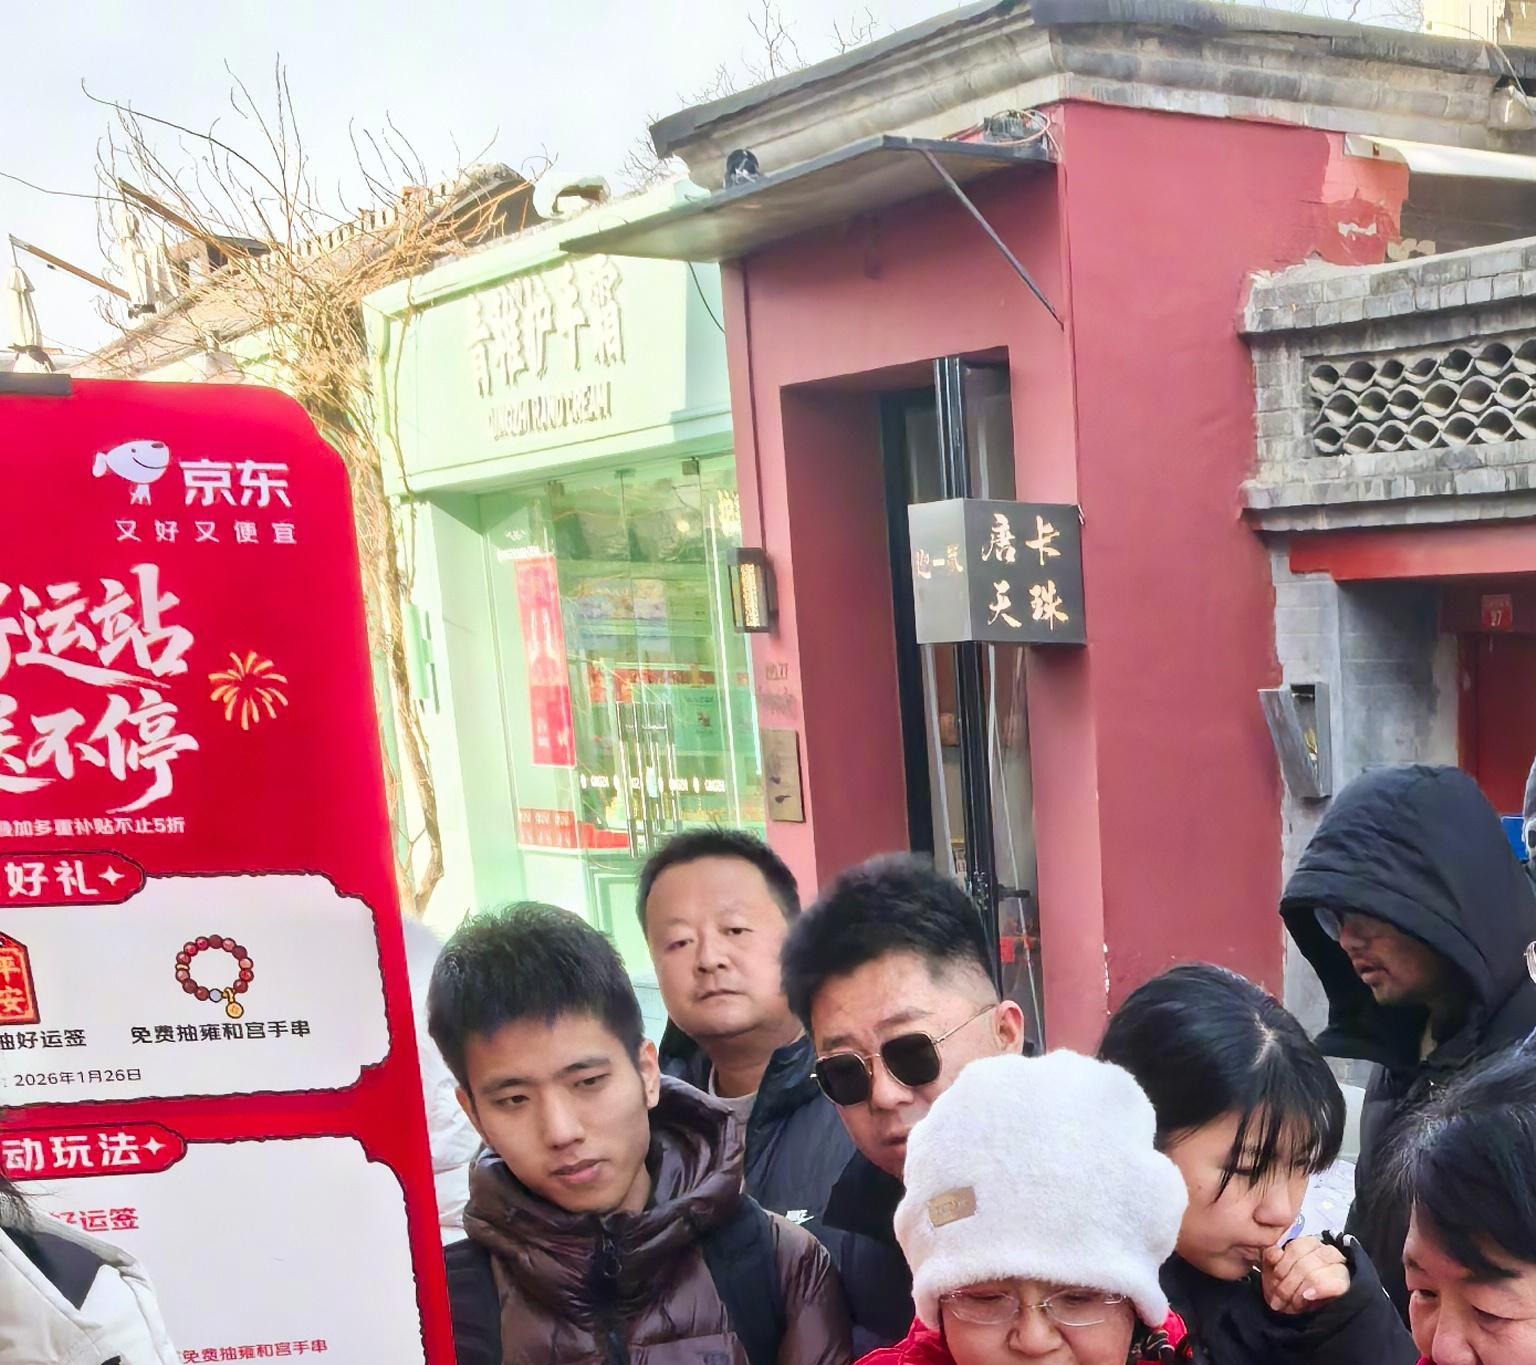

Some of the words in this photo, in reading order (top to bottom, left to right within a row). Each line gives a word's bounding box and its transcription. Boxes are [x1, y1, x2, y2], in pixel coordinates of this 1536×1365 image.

[179, 459, 292, 507] 京东
[115, 519, 297, 544] 又好又便宜
[981, 513, 1060, 565] 唐卡
[4, 860, 100, 897] 好礼
[131, 1019, 312, 1045] 免费抽雍和宫手串
[14, 1068, 142, 1087] 2026年1月26日
[1, 1132, 141, 1171] 动玩法
